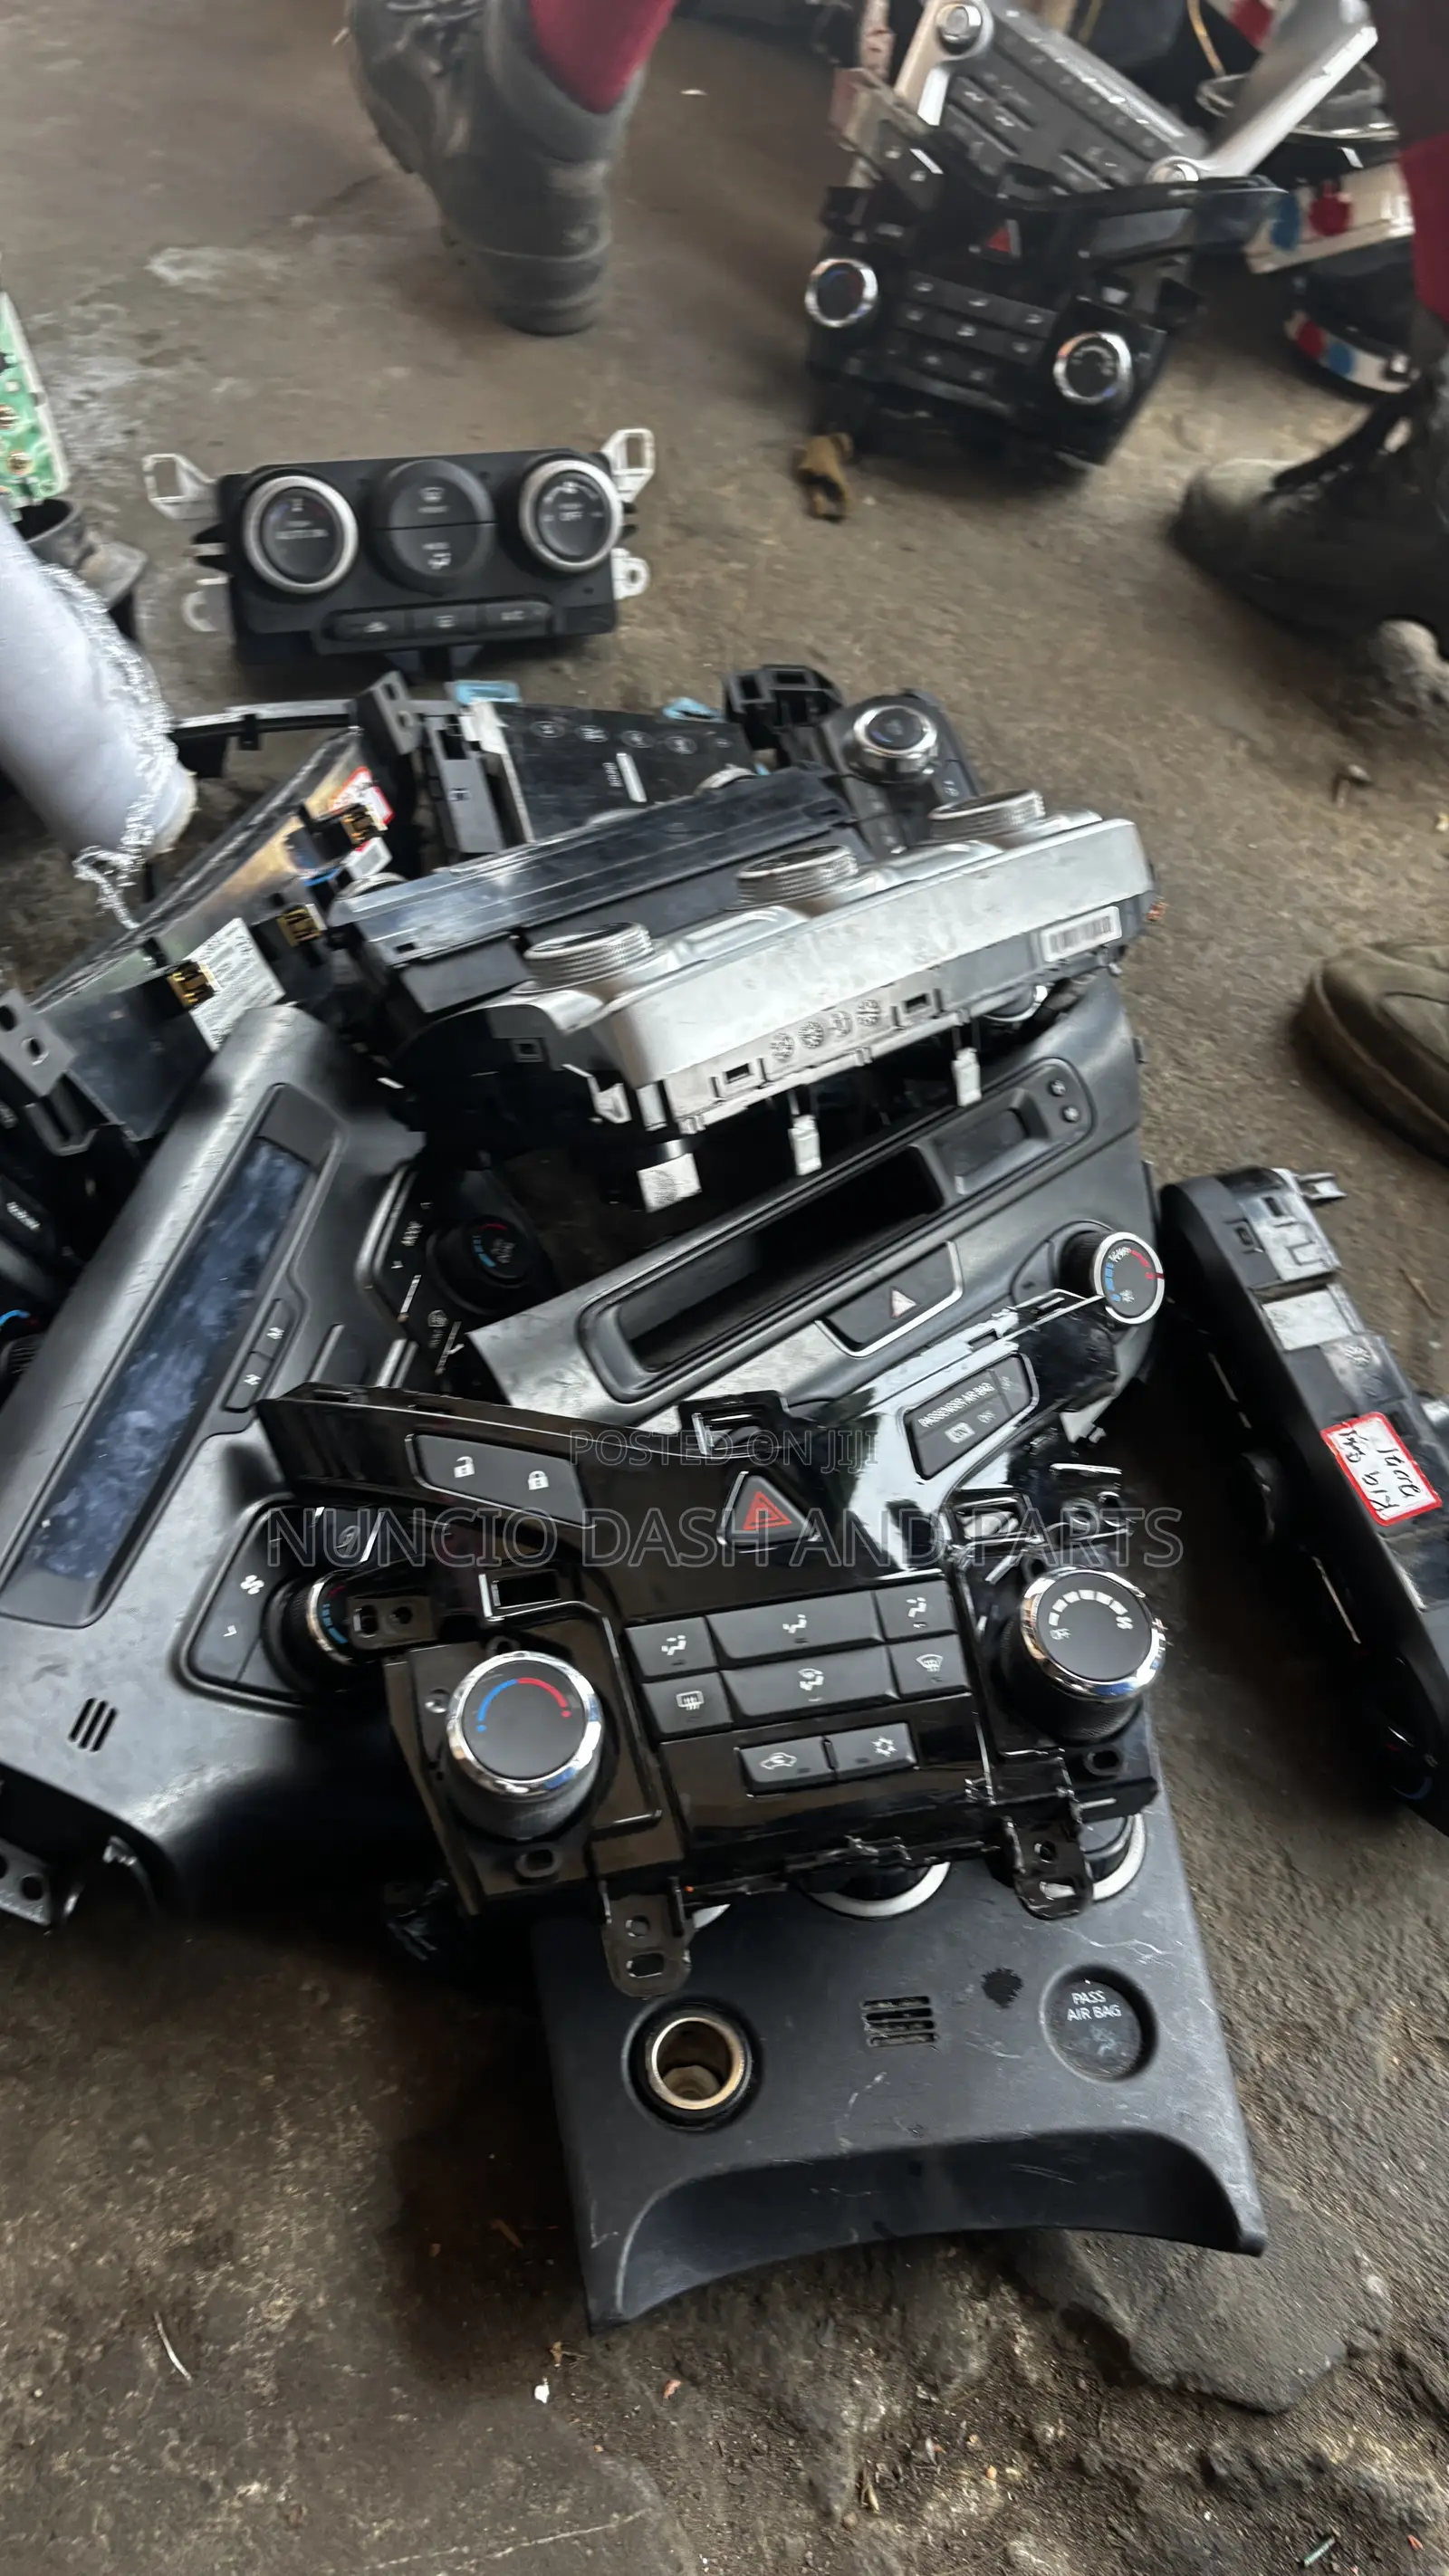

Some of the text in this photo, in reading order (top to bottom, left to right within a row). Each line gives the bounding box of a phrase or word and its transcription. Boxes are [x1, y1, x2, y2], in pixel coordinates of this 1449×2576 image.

[1071, 1989, 1106, 2006] PASS
[1067, 2004, 1122, 2021] AIR BAG
